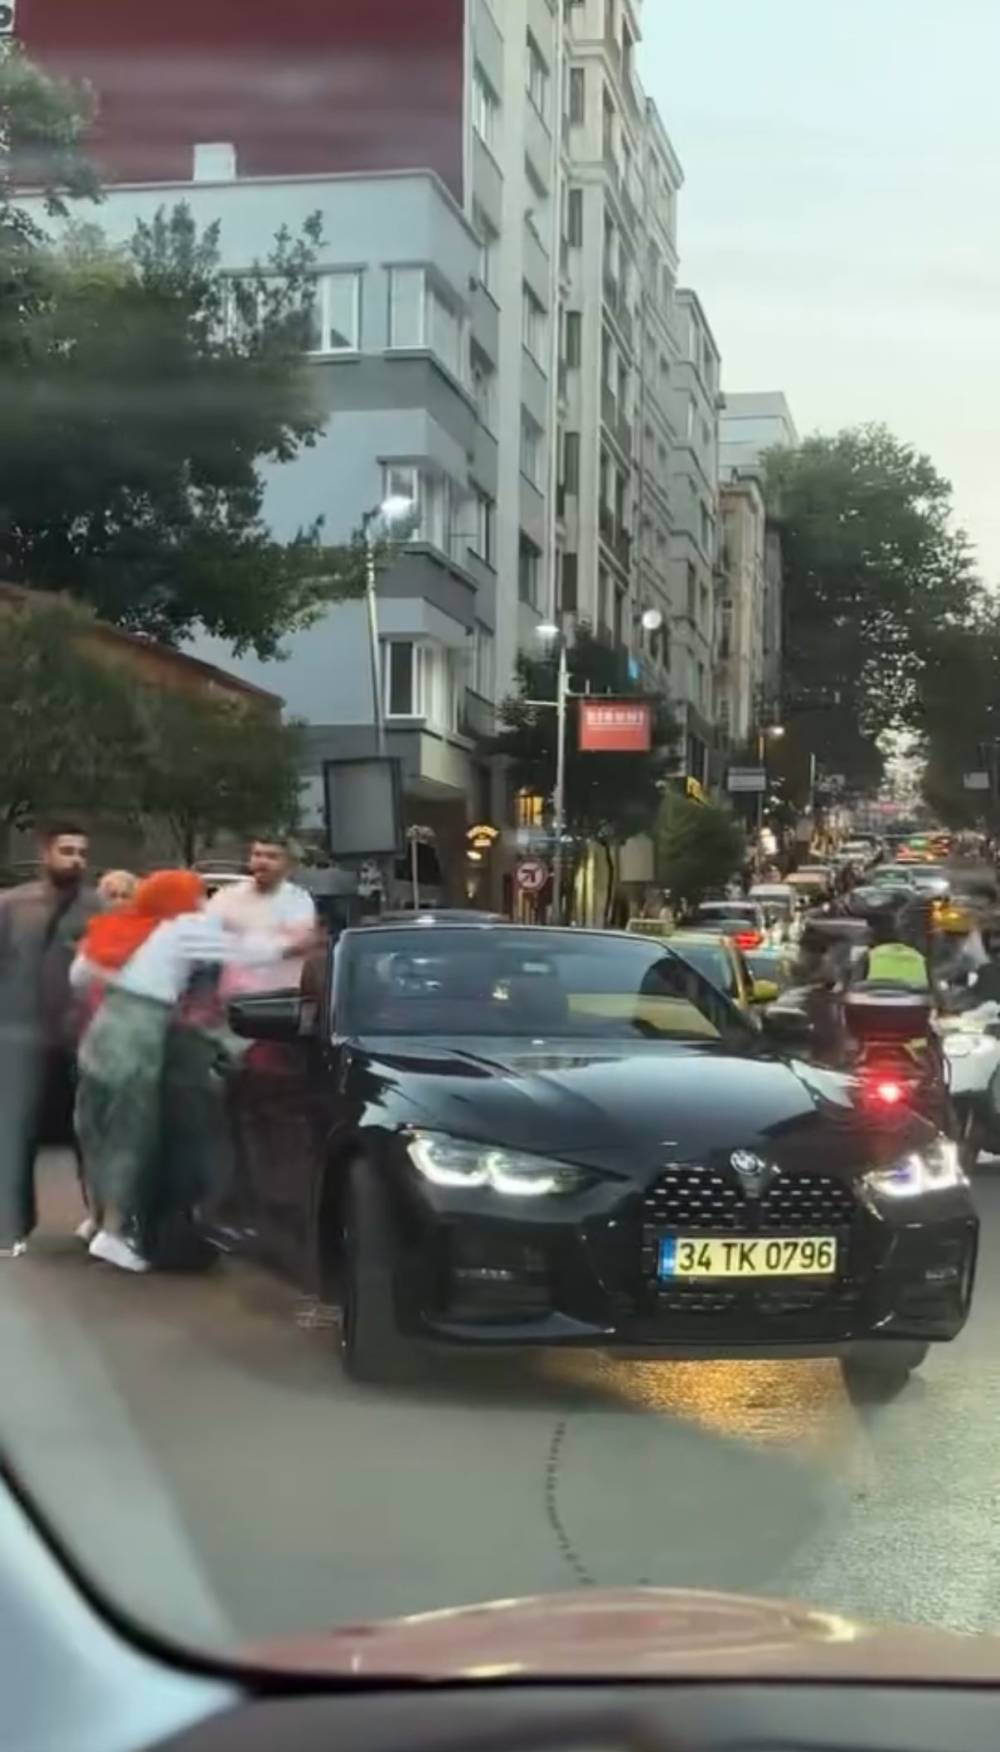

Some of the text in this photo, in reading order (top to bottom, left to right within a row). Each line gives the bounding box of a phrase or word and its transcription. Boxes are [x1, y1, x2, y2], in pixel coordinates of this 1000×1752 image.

[679, 1241, 832, 1271] 34 TK 0796
